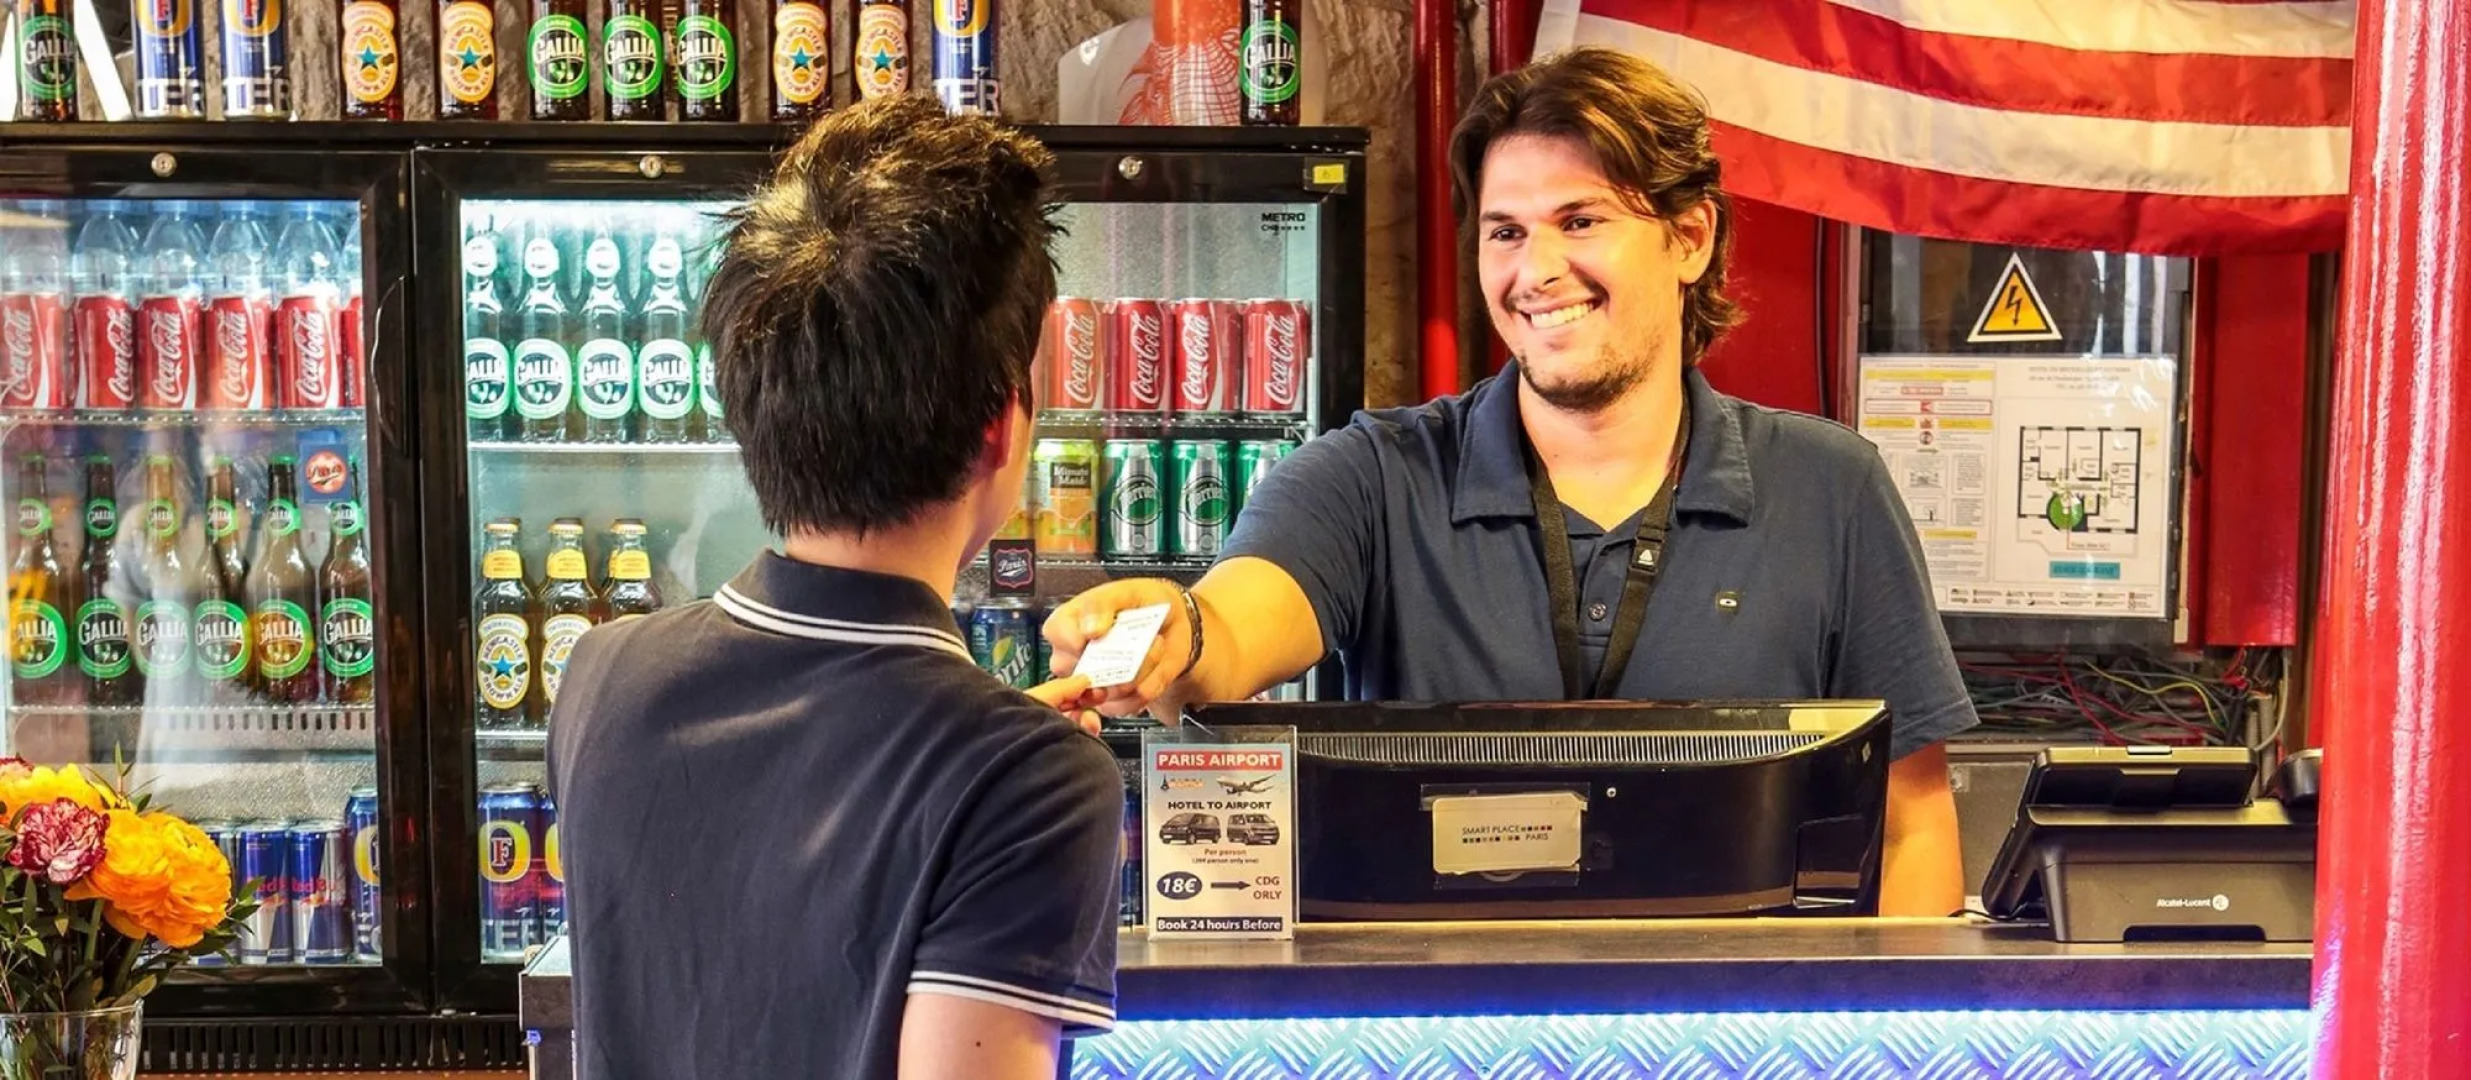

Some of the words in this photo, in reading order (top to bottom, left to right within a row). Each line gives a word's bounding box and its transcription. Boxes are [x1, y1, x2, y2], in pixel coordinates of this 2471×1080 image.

[534, 37, 585, 64] GALLIA
[605, 37, 656, 64] GALLIA
[677, 37, 726, 65] GALLIA
[1244, 43, 1296, 69] GALLIA
[1261, 213, 1305, 221] METRO
[137, 620, 188, 646] GALLIA
[195, 620, 243, 646] GALLIA
[324, 618, 373, 645] GALLIA
[1158, 754, 1207, 766] PARIS
[1209, 754, 1280, 766] AIRPORT
[1168, 801, 1204, 810] HOTEL
[1207, 801, 1223, 810] TO
[1225, 801, 1271, 810] AIRPORT
[1462, 827, 1490, 835] SMART
[1492, 825, 1520, 834] PLACE
[1525, 832, 1549, 841] PARIS
[491, 837, 512, 867] F
[1219, 849, 1247, 857] person
[1162, 878, 1197, 894] 18€
[1255, 876, 1280, 886] CDG
[1253, 890, 1282, 900] ORLY
[2156, 898, 2211, 907] Alcatel-Lucent
[1158, 919, 1188, 930] Book
[1190, 919, 1204, 930] 24
[1206, 919, 1240, 930] hours
[1244, 919, 1281, 930] Before
